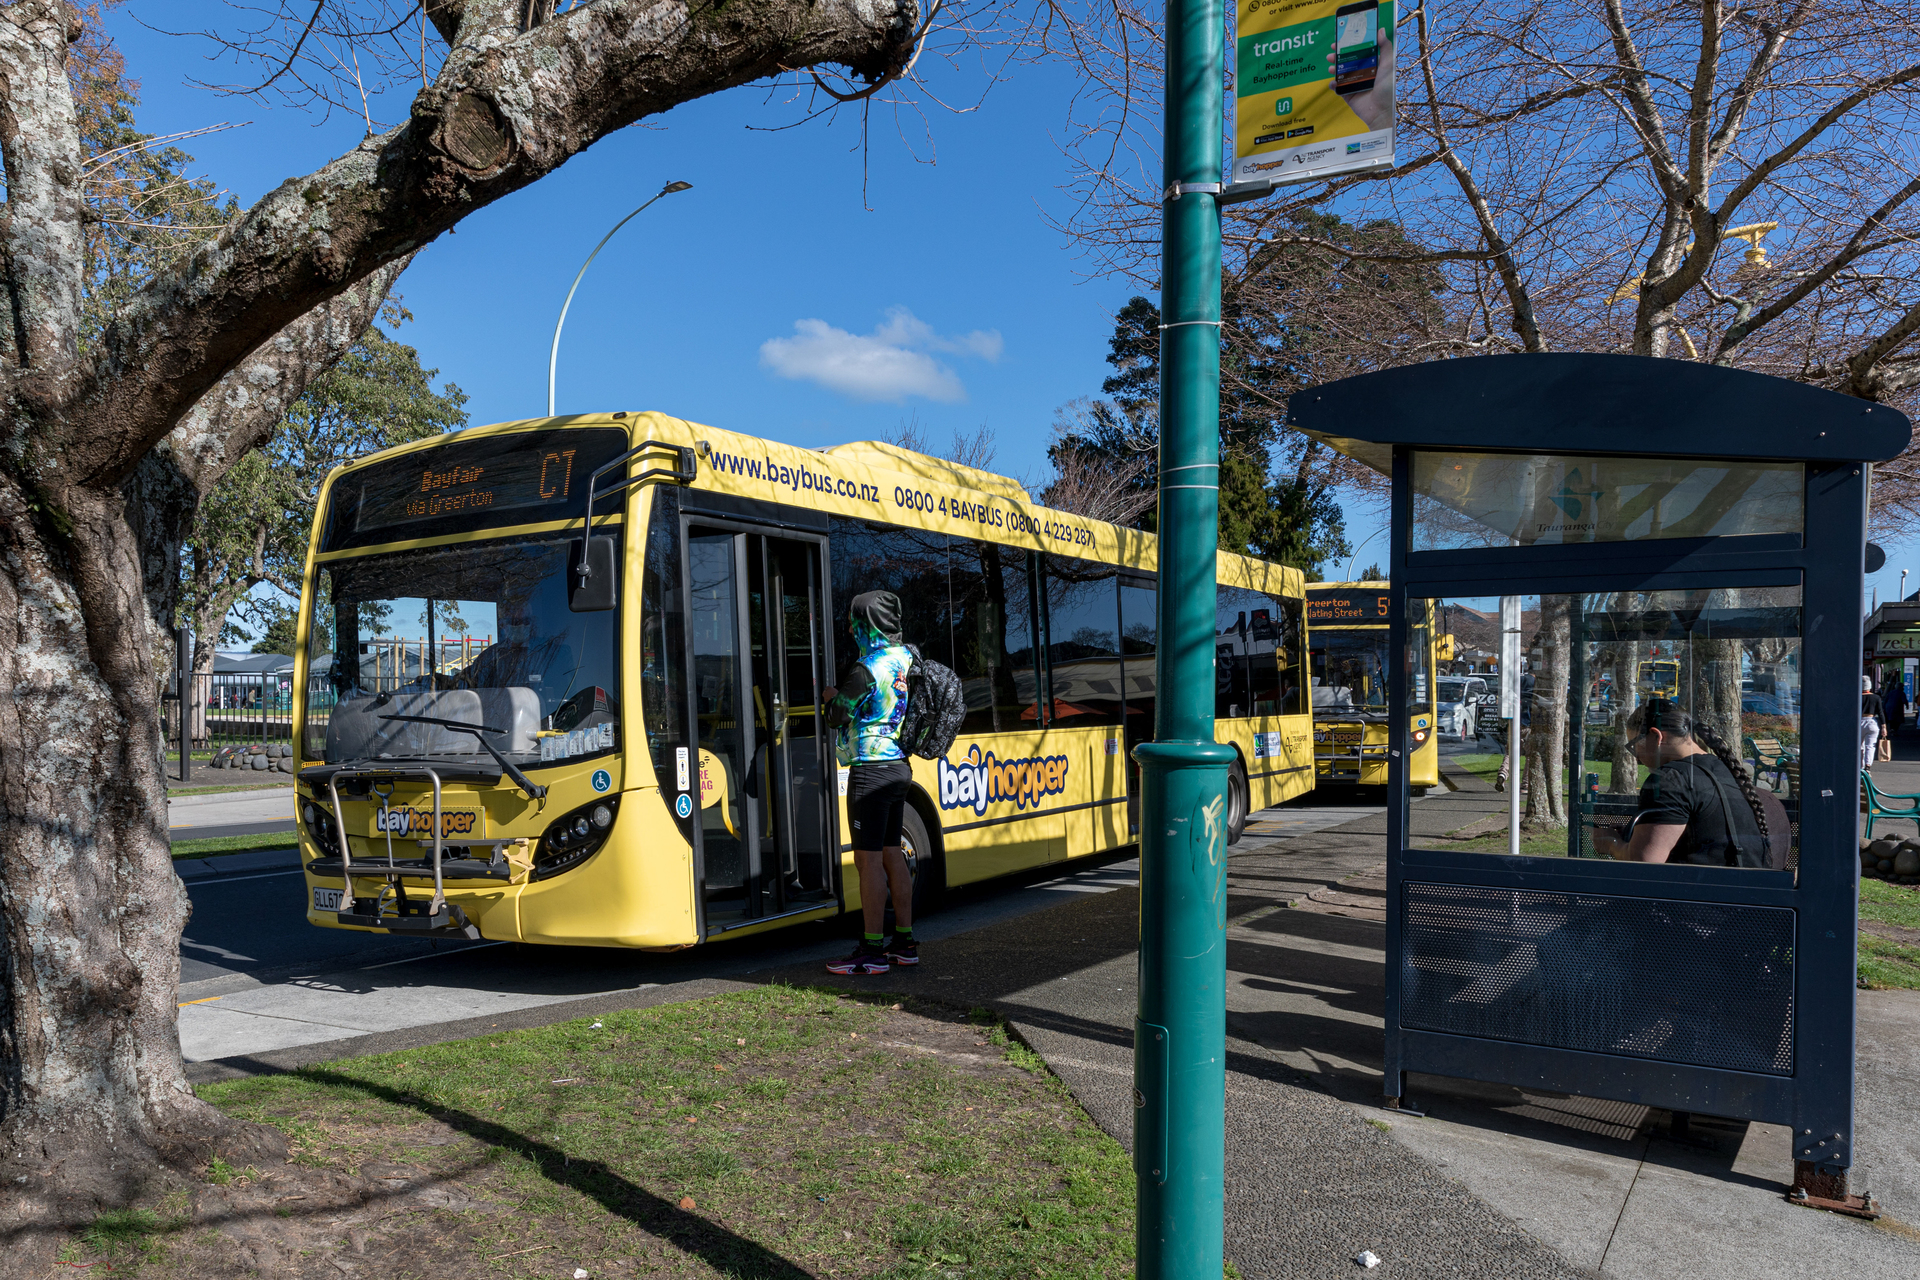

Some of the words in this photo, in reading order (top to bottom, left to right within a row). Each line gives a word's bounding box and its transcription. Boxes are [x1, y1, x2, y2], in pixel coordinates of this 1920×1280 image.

[1279, 4, 1293, 13] visit
[1254, 31, 1319, 57] transit
[1265, 57, 1304, 71] Real-time
[1253, 69, 1298, 84] Bayhopper
[1300, 64, 1316, 74] info
[1262, 119, 1292, 130] Download
[1307, 147, 1336, 156] TRANSPORT
[1243, 159, 1284, 173] bayhopper
[421, 466, 485, 492] Bayfair
[710, 451, 880, 503] www.baybus.co.nz
[406, 499, 426, 516] via
[429, 488, 493, 515] Greerton
[894, 486, 934, 513] 0800
[938, 496, 947, 516] 4
[951, 498, 1003, 527] BAYBUS
[1006, 511, 1041, 536] (0800
[1044, 520, 1051, 538] 4
[1053, 522, 1072, 542] 229
[1074, 527, 1096, 550] 287)
[1536, 522, 1596, 533] Tauranga
[1334, 607, 1363, 618] Street
[1882, 636, 1915, 650] zest
[1478, 694, 1498, 704] ze
[1313, 731, 1363, 743] ayhopper
[699, 770, 709, 779] RE
[701, 780, 713, 790] AG
[937, 748, 1068, 816] bayhopper
